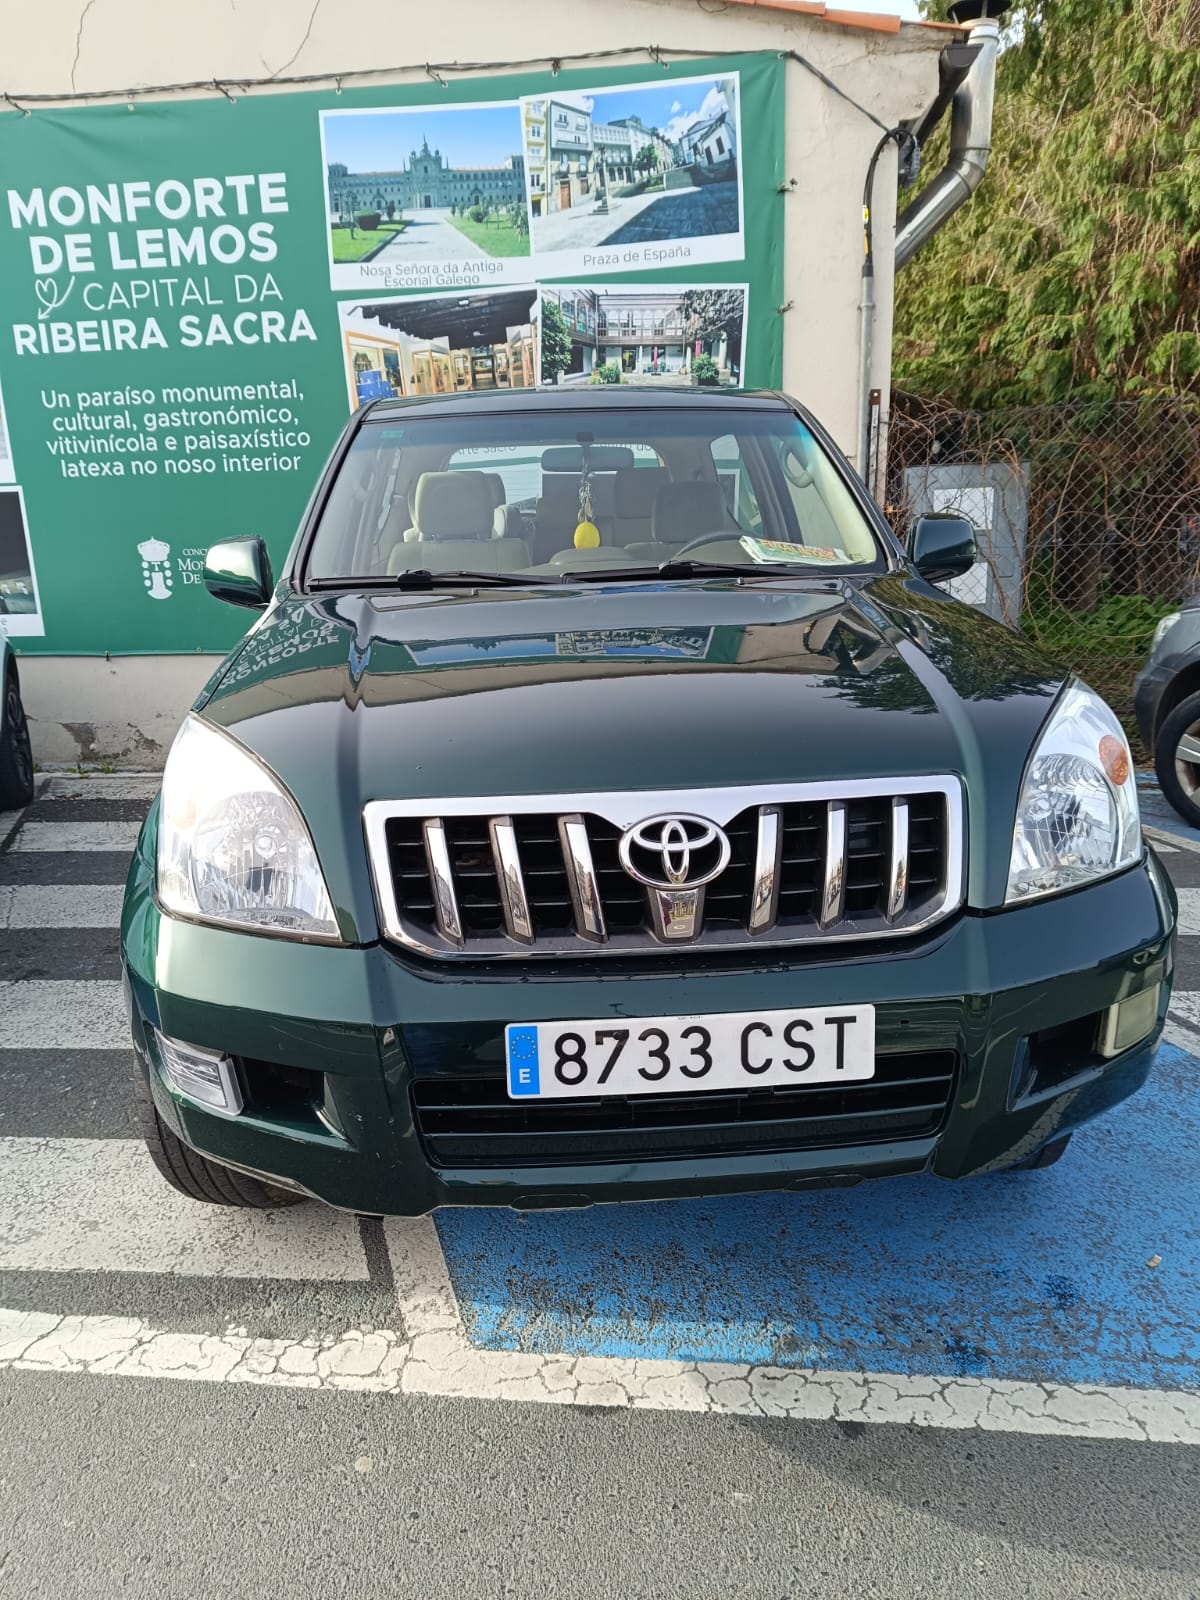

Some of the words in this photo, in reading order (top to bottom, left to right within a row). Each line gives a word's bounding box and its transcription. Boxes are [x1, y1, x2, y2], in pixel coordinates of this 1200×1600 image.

[7, 172, 289, 229] MONFORTE
[28, 233, 96, 275] DE
[108, 221, 278, 271] LEMOS
[583, 254, 619, 267] Praza
[623, 250, 640, 262] de
[644, 246, 691, 262] España
[360, 265, 392, 277] Nosa
[395, 262, 439, 276] Señora
[443, 262, 459, 274] da
[462, 260, 504, 275] Antiga
[384, 274, 432, 288] Escorial
[436, 272, 480, 286] Galego
[82, 276, 224, 312] CAPITAL
[234, 272, 284, 304] DA
[12, 316, 169, 356] RIBEIRA
[179, 308, 318, 348] SACRA
[41, 389, 71, 409] Un
[77, 386, 156, 412] paraíso
[161, 378, 304, 405] monumental,
[52, 409, 138, 432] cultural,
[143, 404, 299, 432] gastronómico,
[46, 434, 158, 456] vitivinícola
[164, 436, 178, 451] e
[183, 428, 311, 454] paisaxístico
[60, 459, 125, 478] latexa
[130, 459, 158, 476] no
[164, 458, 217, 475] noso
[223, 453, 301, 473] interior
[182, 548, 207, 556] CONC
[553, 1026, 713, 1086] 8733
[740, 1015, 857, 1075] CST
[519, 1068, 531, 1084] E
